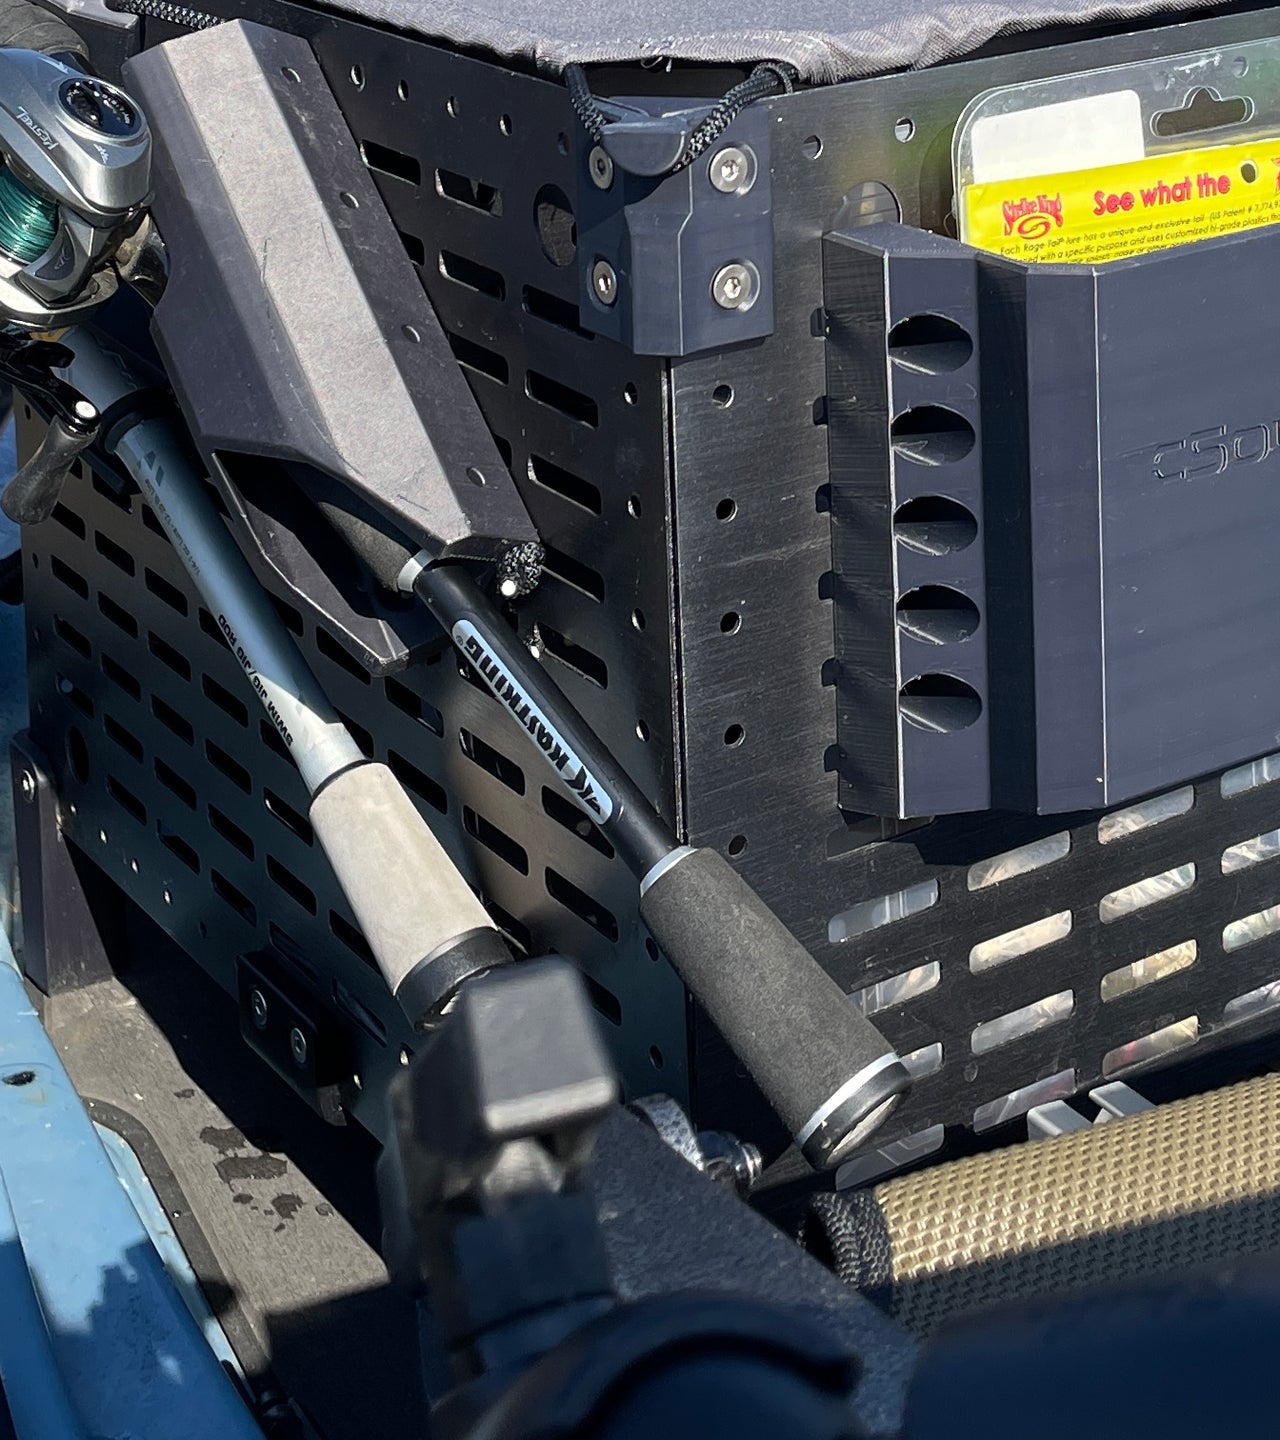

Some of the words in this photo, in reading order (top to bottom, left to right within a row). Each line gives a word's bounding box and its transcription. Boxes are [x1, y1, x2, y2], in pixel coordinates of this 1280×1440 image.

[16, 106, 58, 151] KESTREL
[1093, 190, 1135, 216] See
[1140, 176, 1192, 208] what
[1197, 172, 1231, 198] the
[1024, 241, 1045, 253] Rage
[1084, 231, 1097, 241] has
[1108, 225, 1135, 239] unique
[1138, 221, 1153, 231] and
[1155, 217, 1190, 230] exclusive
[1065, 244, 1094, 258] specific
[1131, 234, 1146, 245] and
[1165, 226, 1209, 240] customized
[218, 614, 237, 647] ROD
[236, 646, 268, 700] JIG/JIG
[267, 700, 294, 747] SWIM
